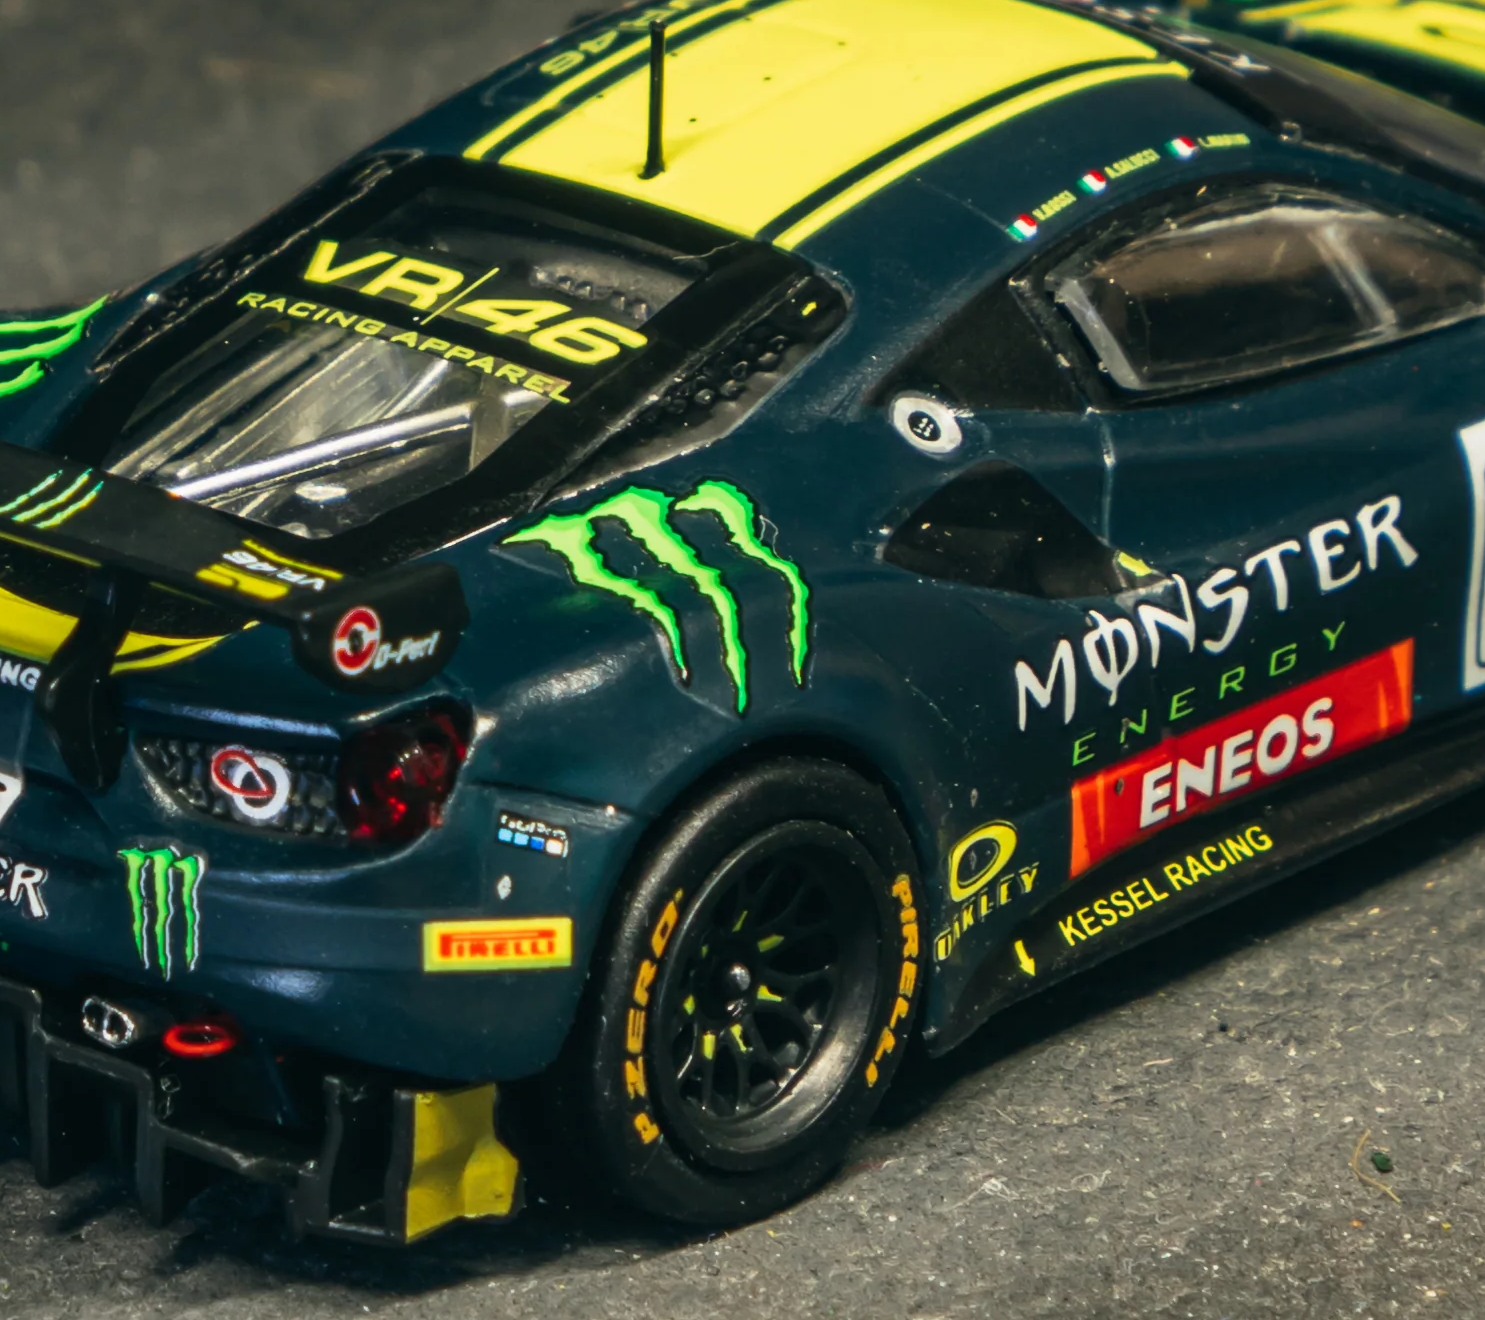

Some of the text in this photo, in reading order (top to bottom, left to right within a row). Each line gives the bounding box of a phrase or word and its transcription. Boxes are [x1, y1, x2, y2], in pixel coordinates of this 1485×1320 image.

[235, 292, 573, 405] RACING APPAREL
[1071, 620, 1347, 767] ENERGY
[1139, 696, 1335, 829] ENEOS
[439, 929, 557, 959] PIRELLI
[934, 861, 1040, 962] OAKLEY
[1058, 825, 1273, 946] KESSEL RACING
